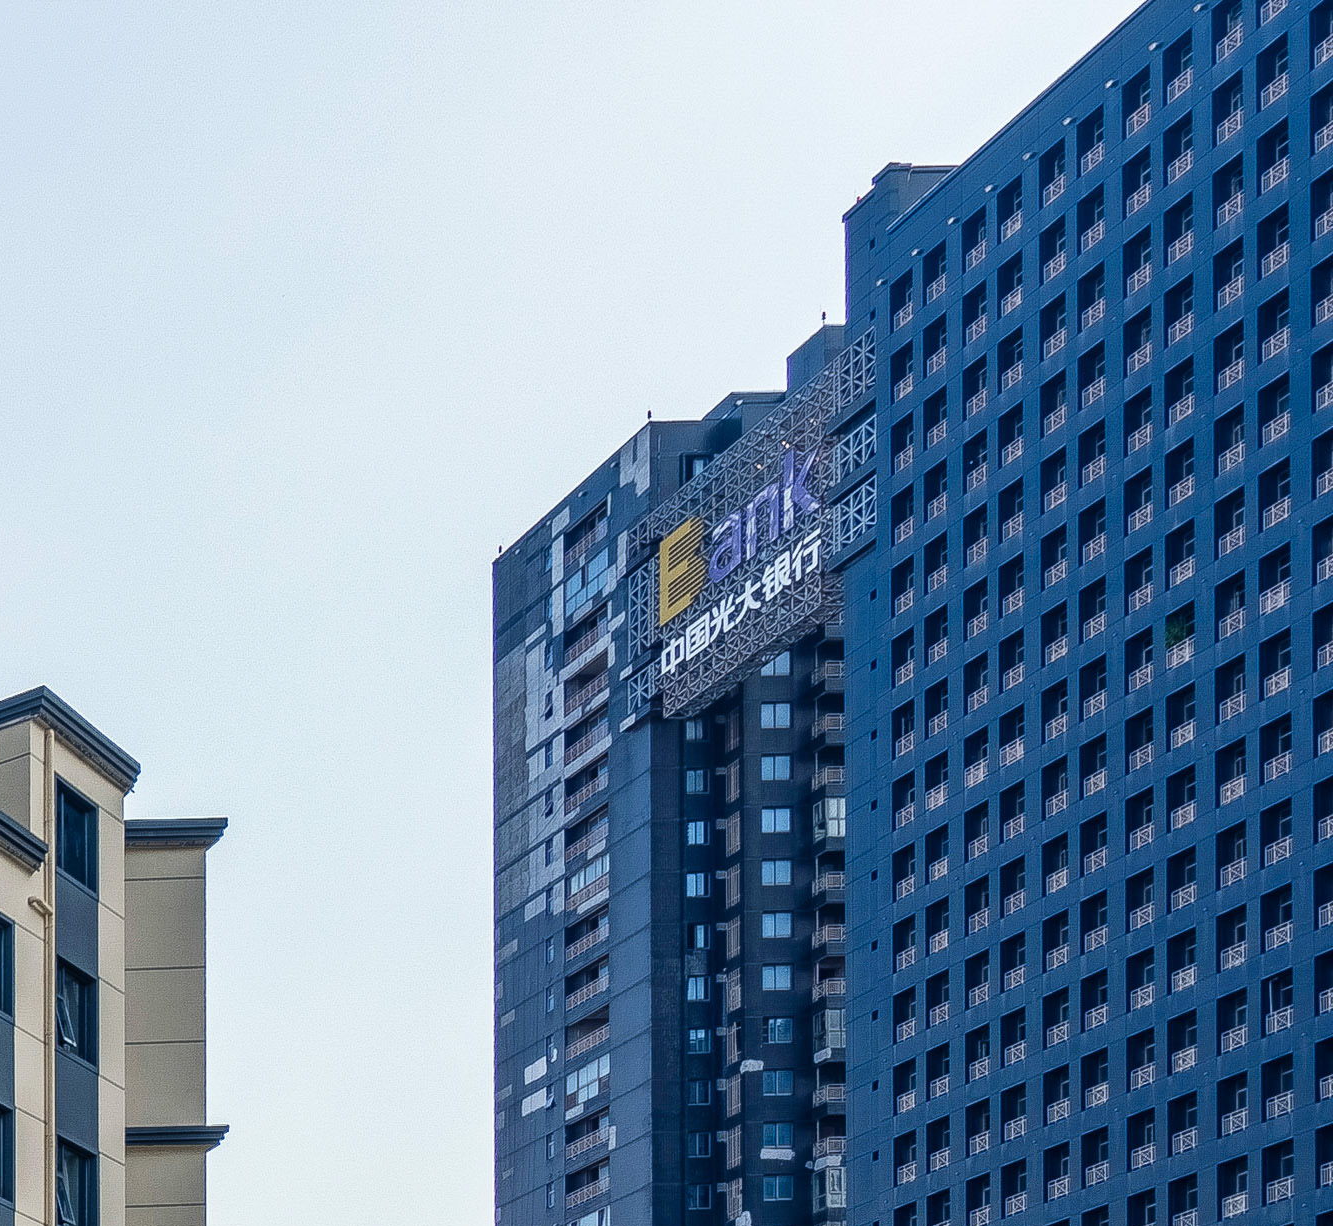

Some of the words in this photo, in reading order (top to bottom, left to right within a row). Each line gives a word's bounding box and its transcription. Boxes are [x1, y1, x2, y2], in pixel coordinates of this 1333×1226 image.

[661, 529, 822, 676] 中国光大银行
